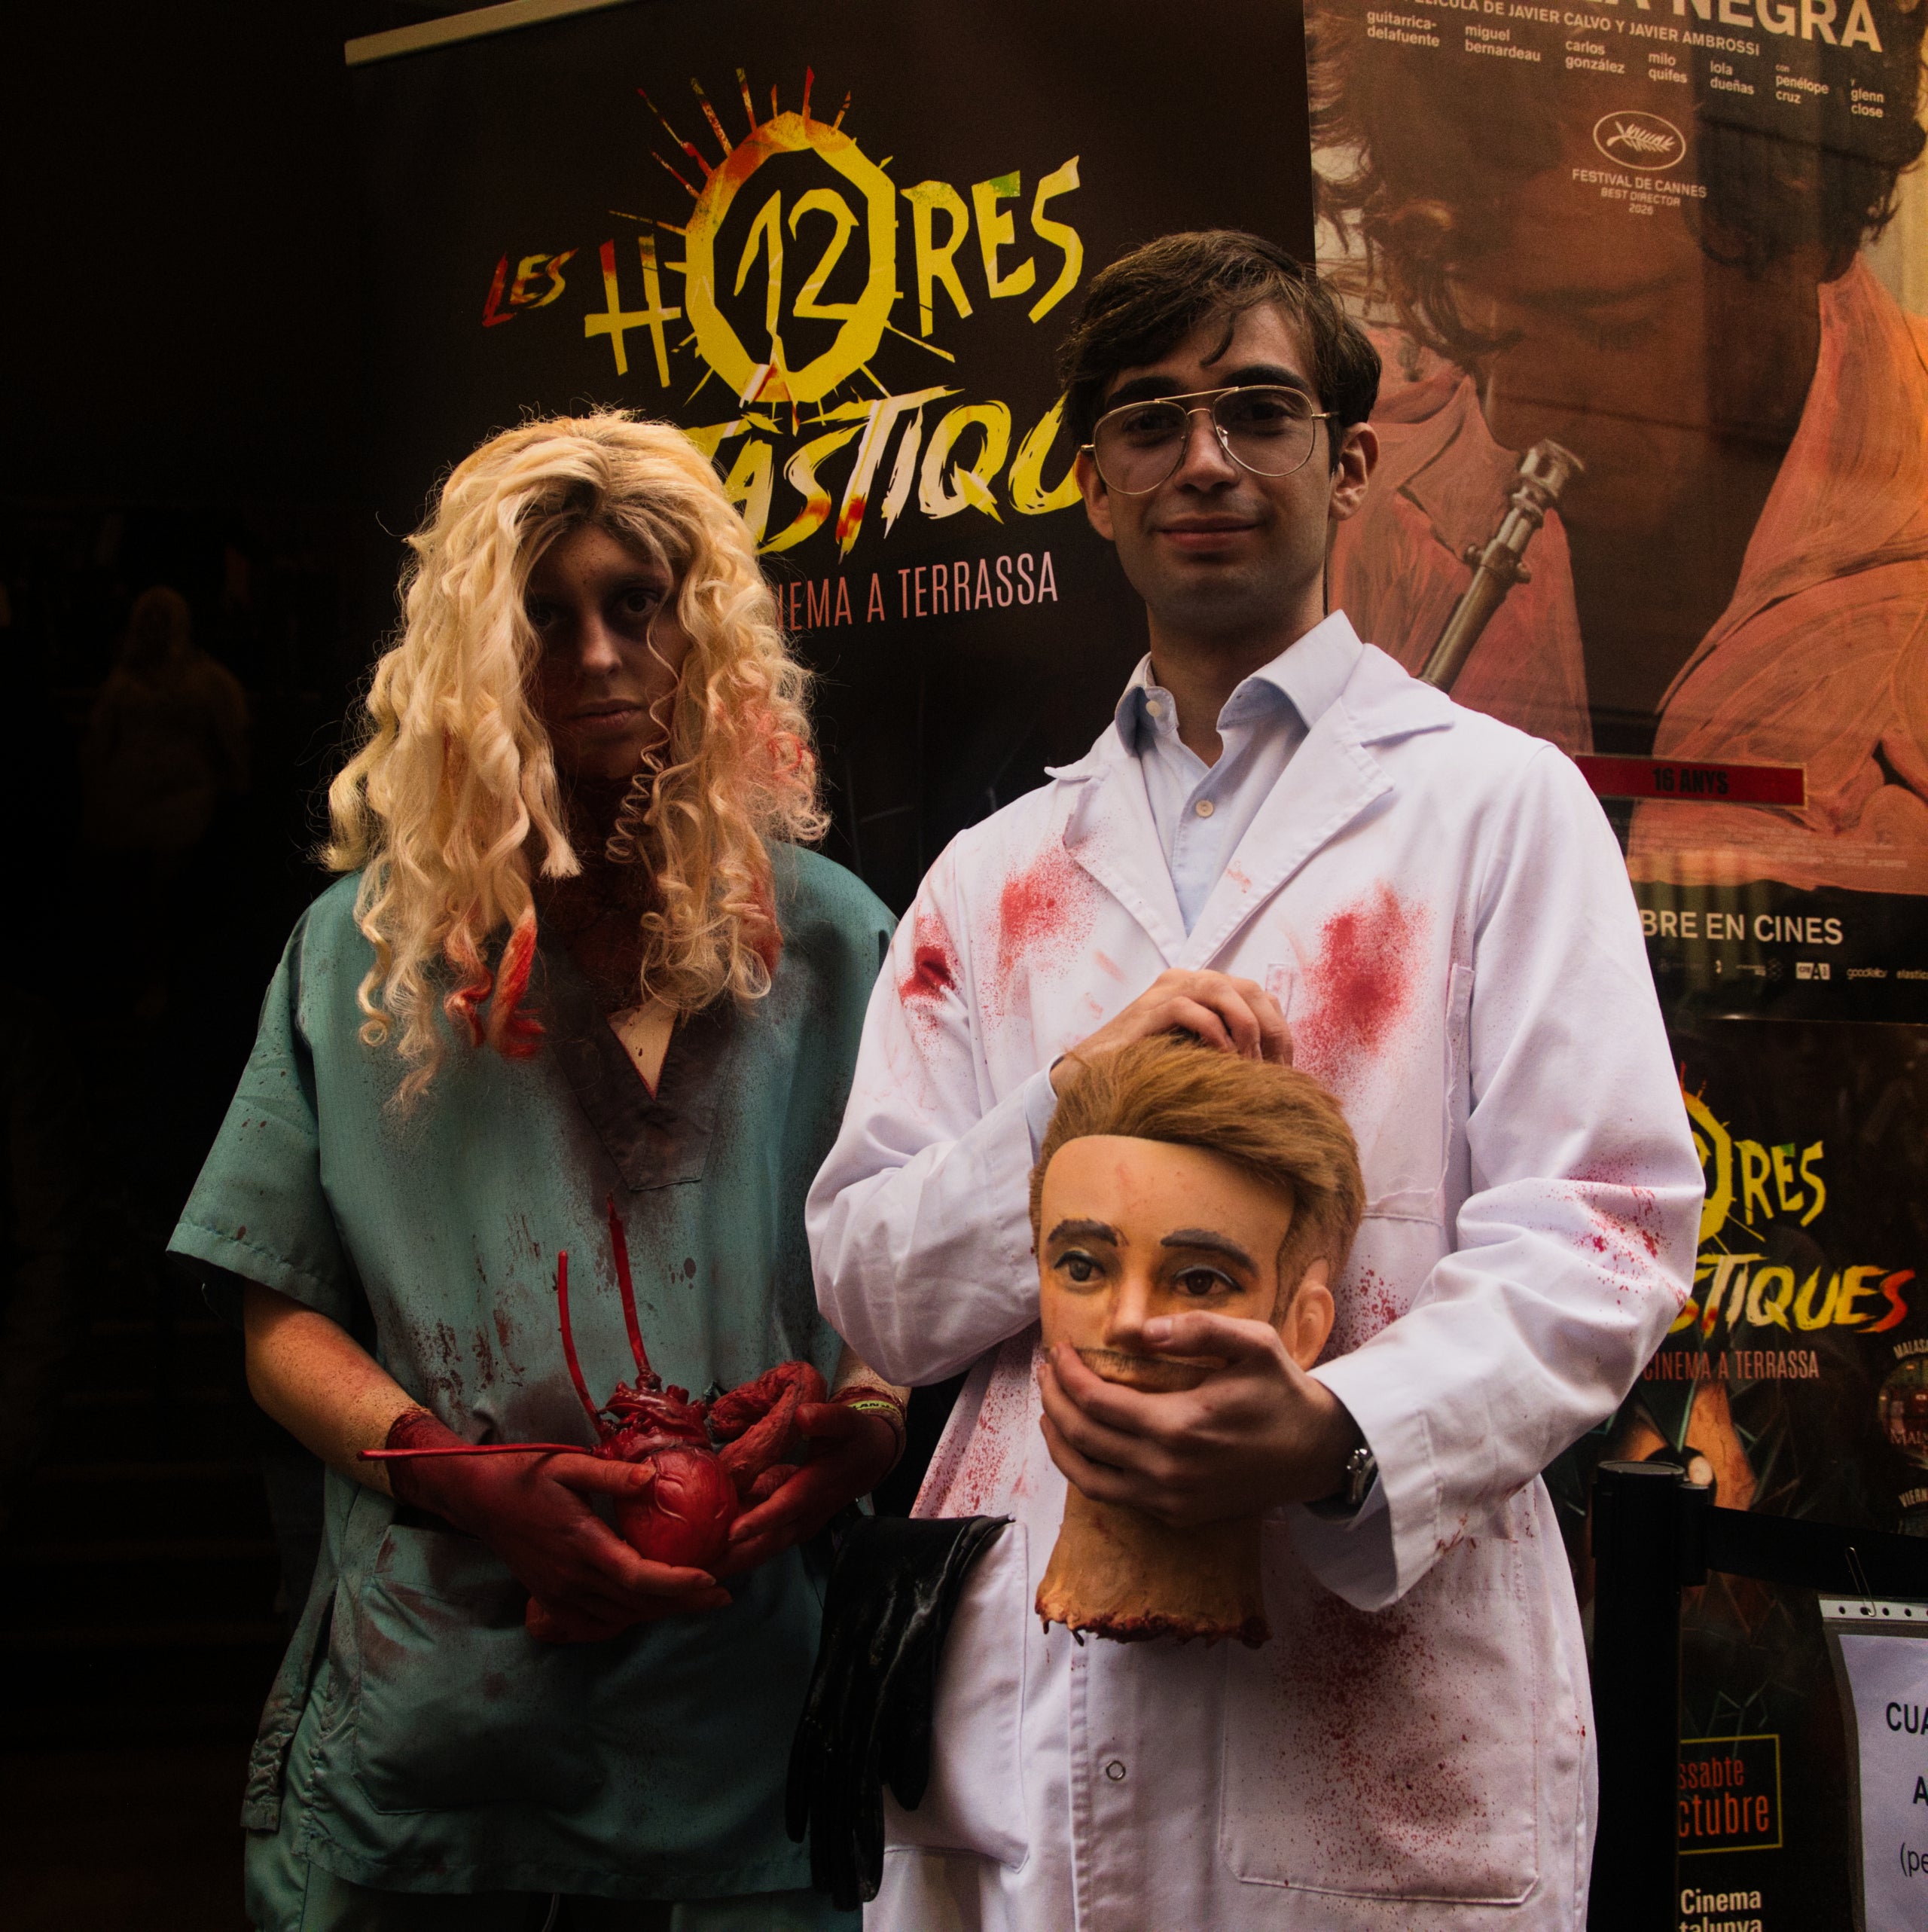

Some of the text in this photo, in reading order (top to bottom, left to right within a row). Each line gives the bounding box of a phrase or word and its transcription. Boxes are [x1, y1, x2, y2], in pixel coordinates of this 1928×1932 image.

[1367, 10, 1437, 30] guitarrica-
[1483, 1, 1505, 15] DE
[1509, 5, 1560, 24] JAVIER
[1564, 12, 1610, 31] CALVO
[1615, 20, 1625, 33] Y
[1629, 22, 1679, 42] JAVIER
[1682, 32, 1760, 56] AMBROSSI
[1367, 26, 1440, 47] delafuente
[1465, 24, 1510, 41] miguel
[1465, 39, 1541, 62] bernardeau
[1566, 39, 1605, 55] carlos
[1566, 55, 1625, 74] gonzález
[1649, 52, 1676, 66] milo
[1710, 60, 1733, 75] lola
[1649, 66, 1688, 84] quifes
[1776, 75, 1829, 95] penélope
[1710, 76, 1754, 95] dueñas
[1850, 88, 1884, 103] glenn
[1776, 90, 1801, 105] cruz
[1850, 102, 1883, 118] close
[1573, 168, 1707, 198] FESTIVAL DE CANNES
[1601, 187, 1680, 206] BEST DIRECTOR
[734, 188, 860, 337] 12
[482, 247, 579, 328] LES
[866, 572, 886, 623] A
[898, 551, 1058, 619] TERRASSA
[1652, 767, 1729, 795] 16 ANYS
[1706, 913, 1745, 941] EN
[1753, 914, 1844, 945] CINES
[1718, 1350, 1730, 1380] A
[1734, 1350, 1820, 1380] TERRASSA
[1680, 1888, 1762, 1915] Cinema
